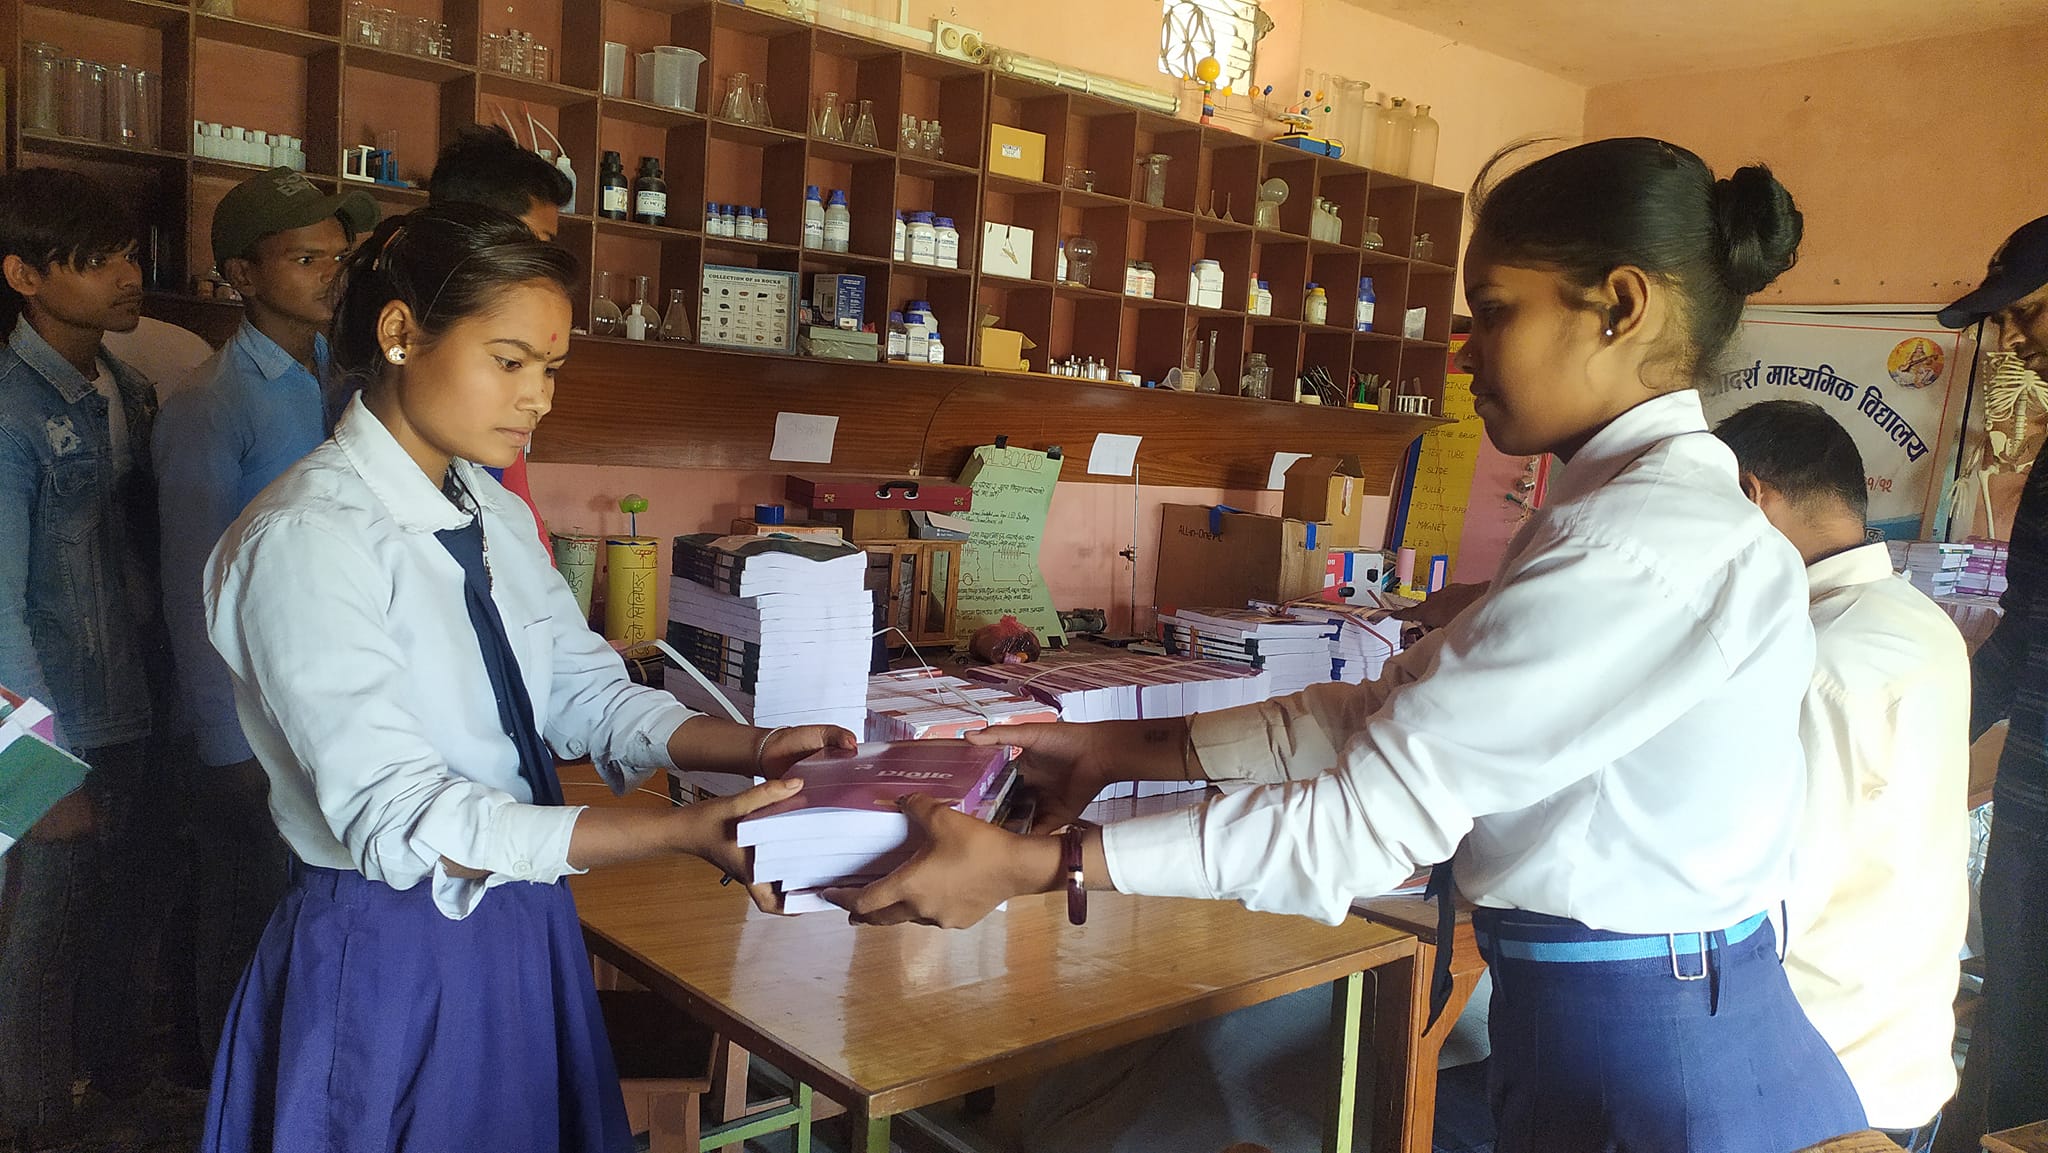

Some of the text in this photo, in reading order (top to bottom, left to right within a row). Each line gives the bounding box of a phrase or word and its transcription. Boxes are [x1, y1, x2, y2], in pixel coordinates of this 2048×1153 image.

[708, 273, 745, 282] COLLECTION
[1766, 363, 1859, 402] माध्यमिक
[1857, 385, 1930, 463] विद्यालय
[1867, 476, 1893, 493] १/१२
